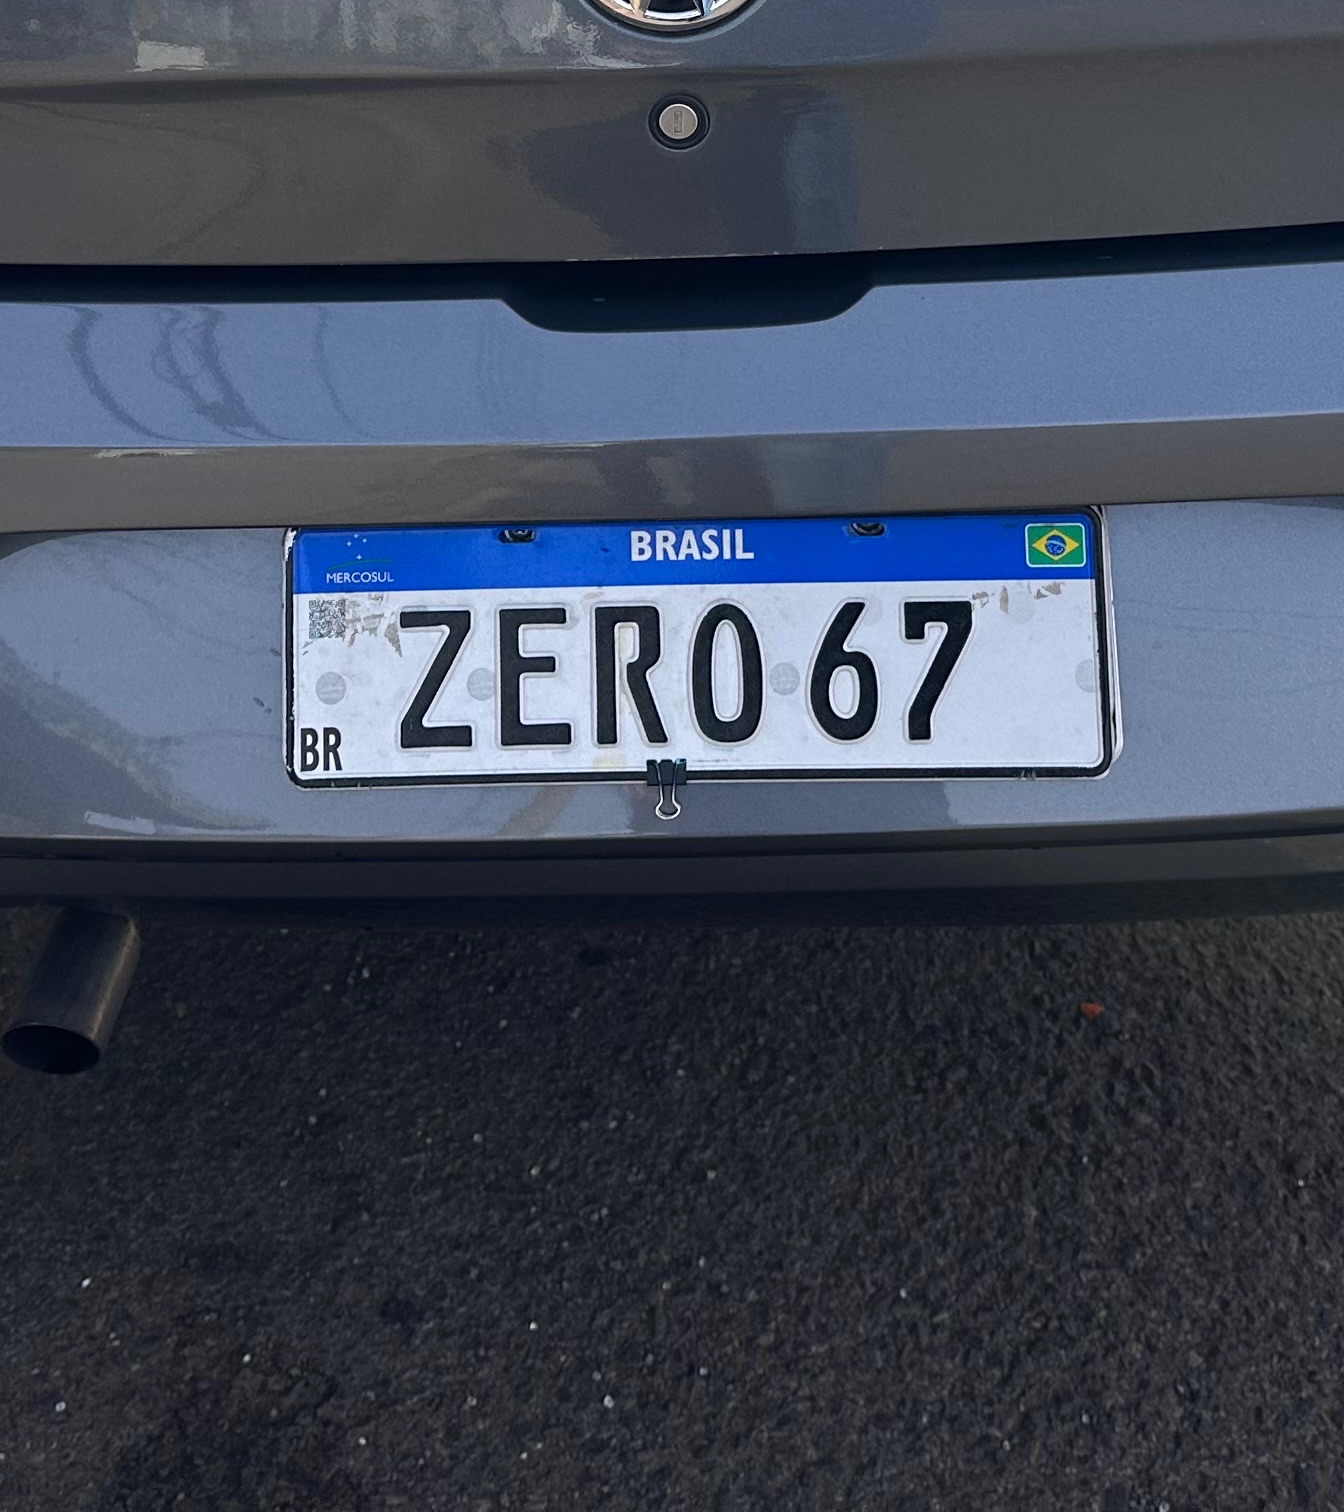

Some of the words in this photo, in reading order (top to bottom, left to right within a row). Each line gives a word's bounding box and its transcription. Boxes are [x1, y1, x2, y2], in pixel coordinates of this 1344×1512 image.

[630, 528, 755, 562] BRASIL
[325, 571, 395, 584] MERCOSUL
[808, 600, 973, 742] 67
[299, 726, 344, 772] BR
